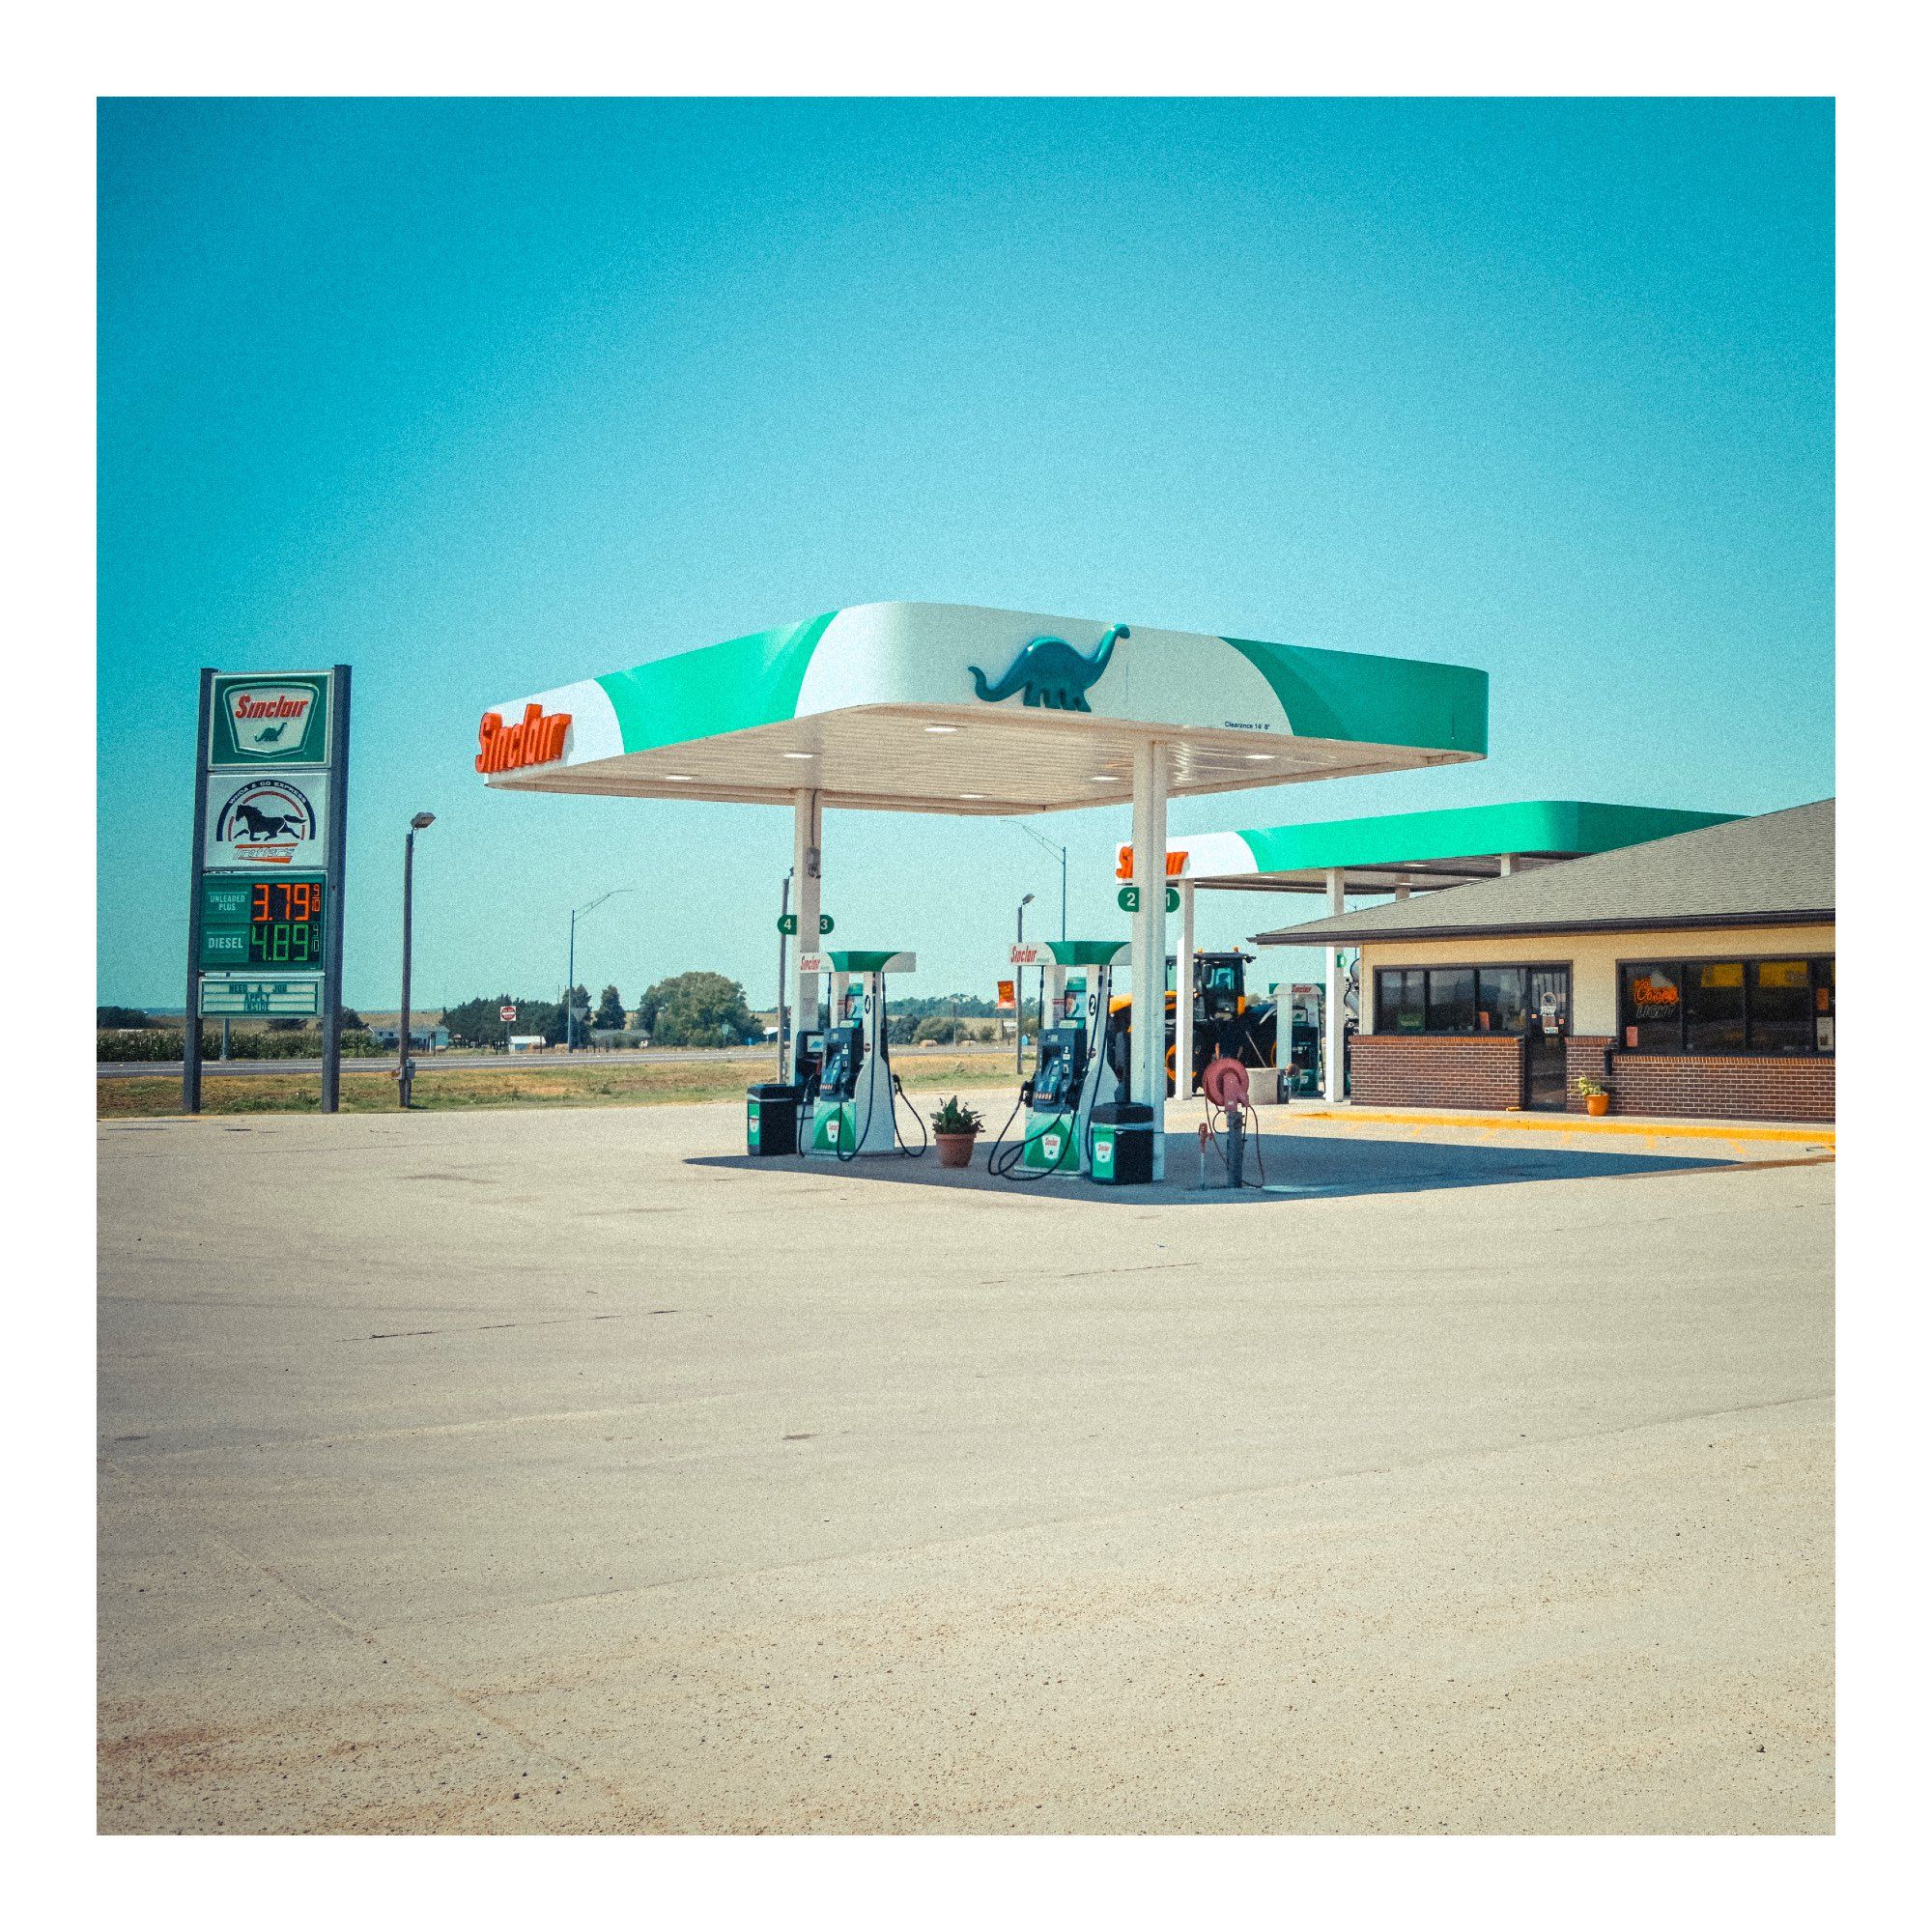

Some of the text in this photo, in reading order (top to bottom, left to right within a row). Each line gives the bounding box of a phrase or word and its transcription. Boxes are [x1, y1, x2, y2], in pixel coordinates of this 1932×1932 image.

[235, 694, 308, 719] Sinclair
[1224, 721, 1253, 729] Clearance
[475, 703, 572, 774] Sinclair
[210, 895, 245, 903] UNLEADED
[252, 883, 309, 921] 3.79
[1126, 893, 1136, 906] 2
[218, 902, 236, 911] PLUS
[783, 918, 792, 930] 4
[821, 919, 828, 930] 3
[208, 937, 243, 949] DIESEL
[251, 923, 308, 961] 4.89
